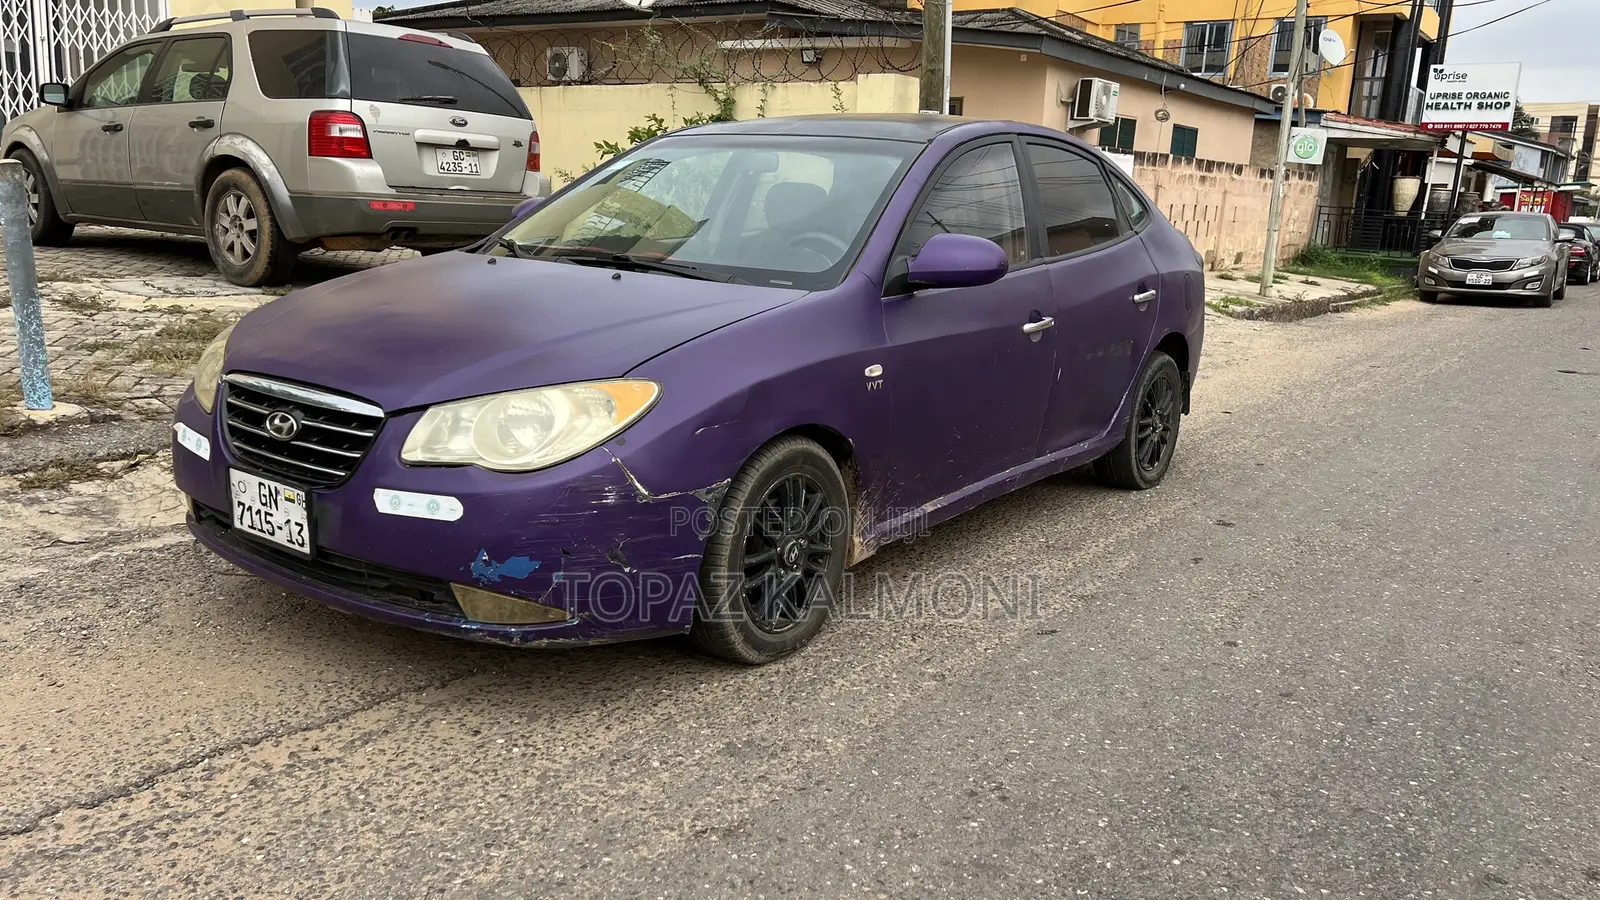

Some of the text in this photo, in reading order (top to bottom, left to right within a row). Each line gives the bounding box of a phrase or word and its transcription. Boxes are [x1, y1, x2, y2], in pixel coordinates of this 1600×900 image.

[1429, 91, 1510, 100] UPRISE ORGANIC
[1425, 101, 1511, 111] HEALTH SHOP
[1296, 141, 1315, 154] glo
[452, 150, 465, 161] GC
[439, 161, 480, 174] 4235-11
[866, 379, 884, 391] VVT
[258, 481, 279, 511] GN
[237, 500, 305, 548] 7115-13
